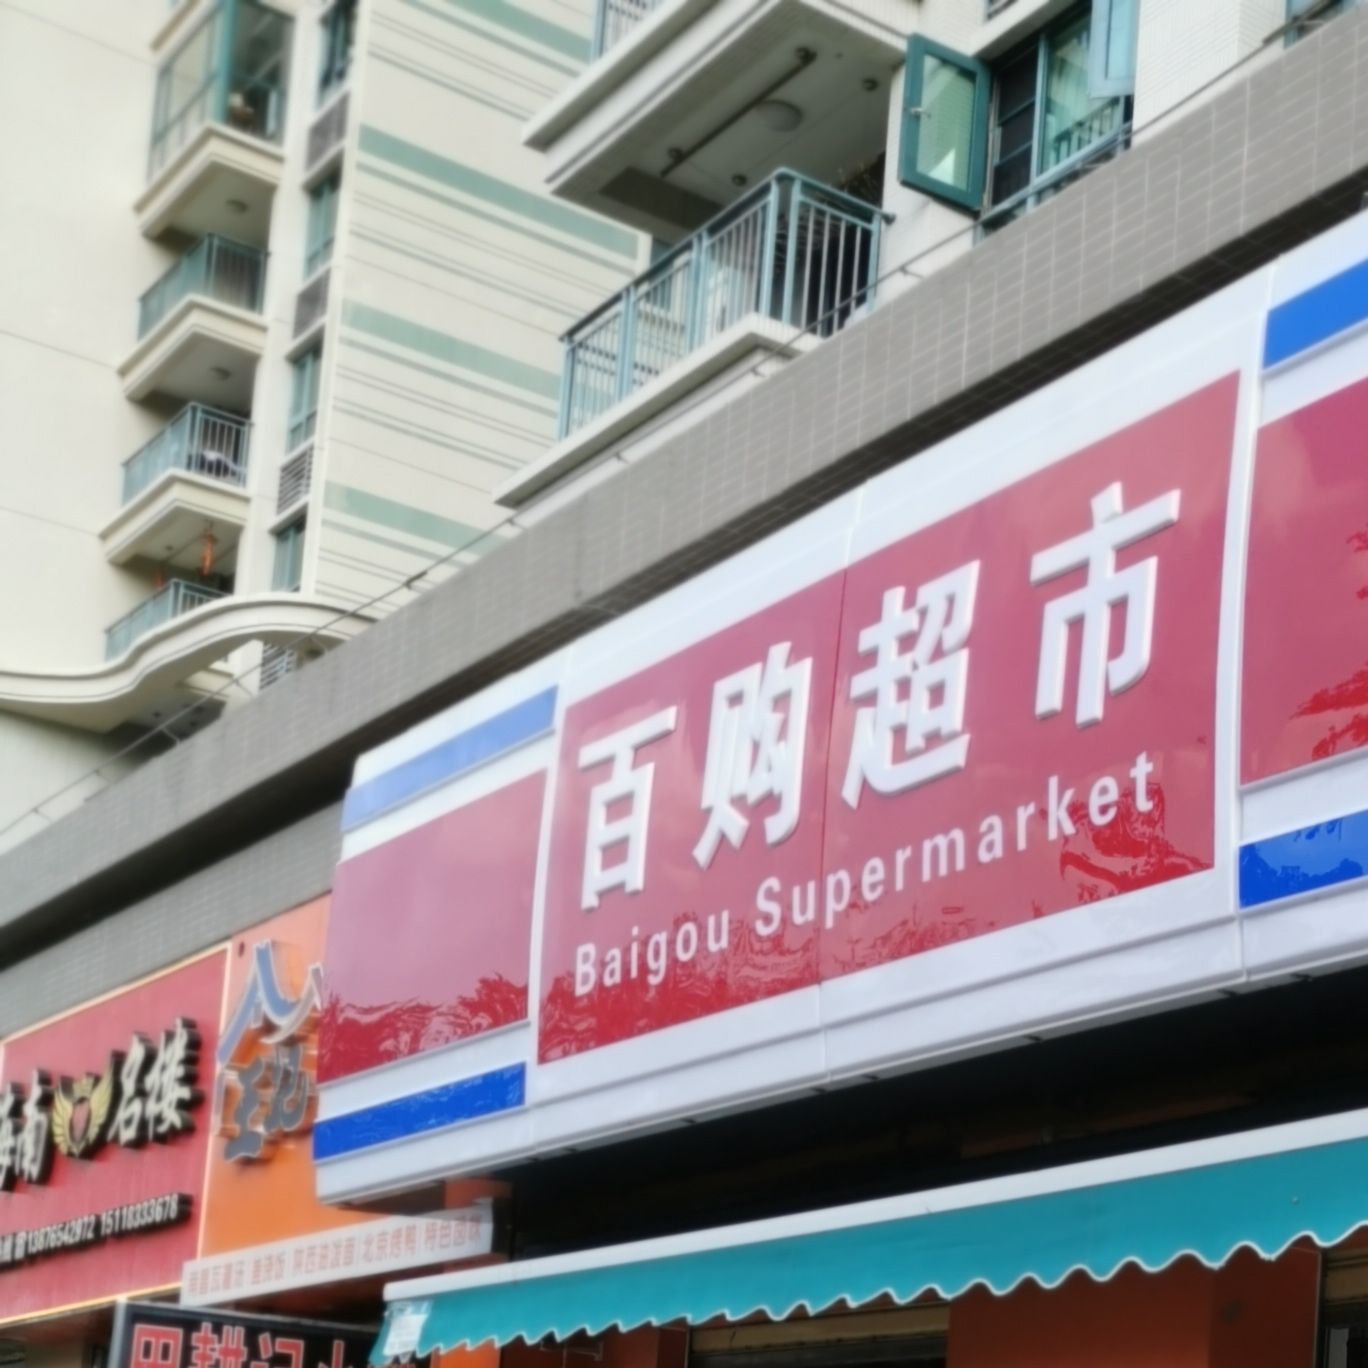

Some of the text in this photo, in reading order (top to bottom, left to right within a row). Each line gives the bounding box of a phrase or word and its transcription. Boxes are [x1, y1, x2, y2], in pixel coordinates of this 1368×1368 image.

[578, 482, 1181, 911] 百购超市
[574, 752, 1155, 997] Baigou Supermarket
